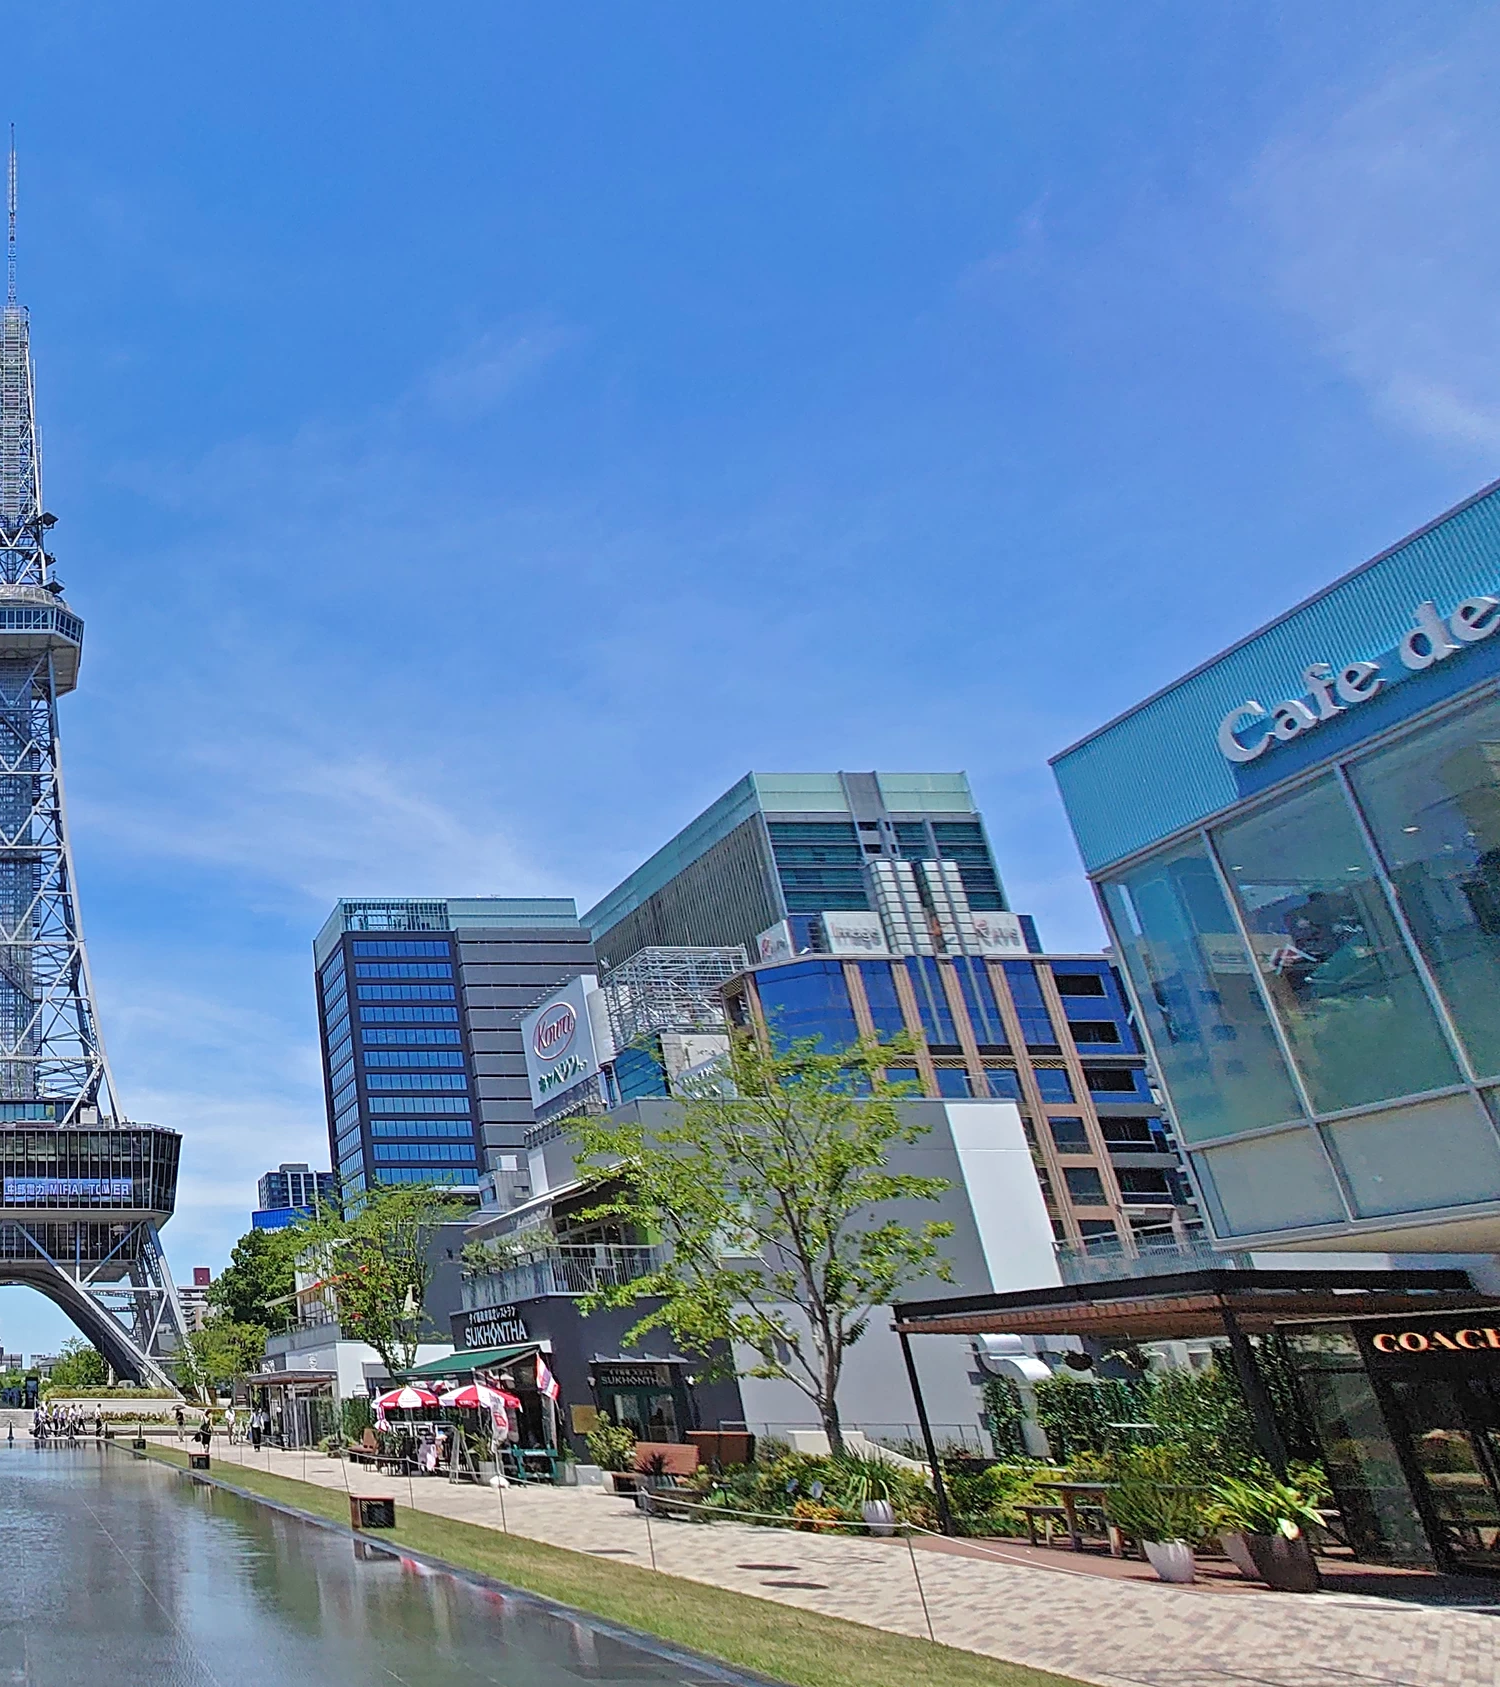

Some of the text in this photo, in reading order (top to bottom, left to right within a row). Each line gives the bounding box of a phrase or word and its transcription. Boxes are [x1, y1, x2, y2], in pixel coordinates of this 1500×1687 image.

[1218, 596, 1500, 762] Cafe de
[49, 1184, 83, 1195] MIRAI
[90, 1184, 128, 1195] TOWER
[465, 1319, 528, 1347] SUKHONTHA
[601, 1376, 667, 1386] SUKHONTHA
